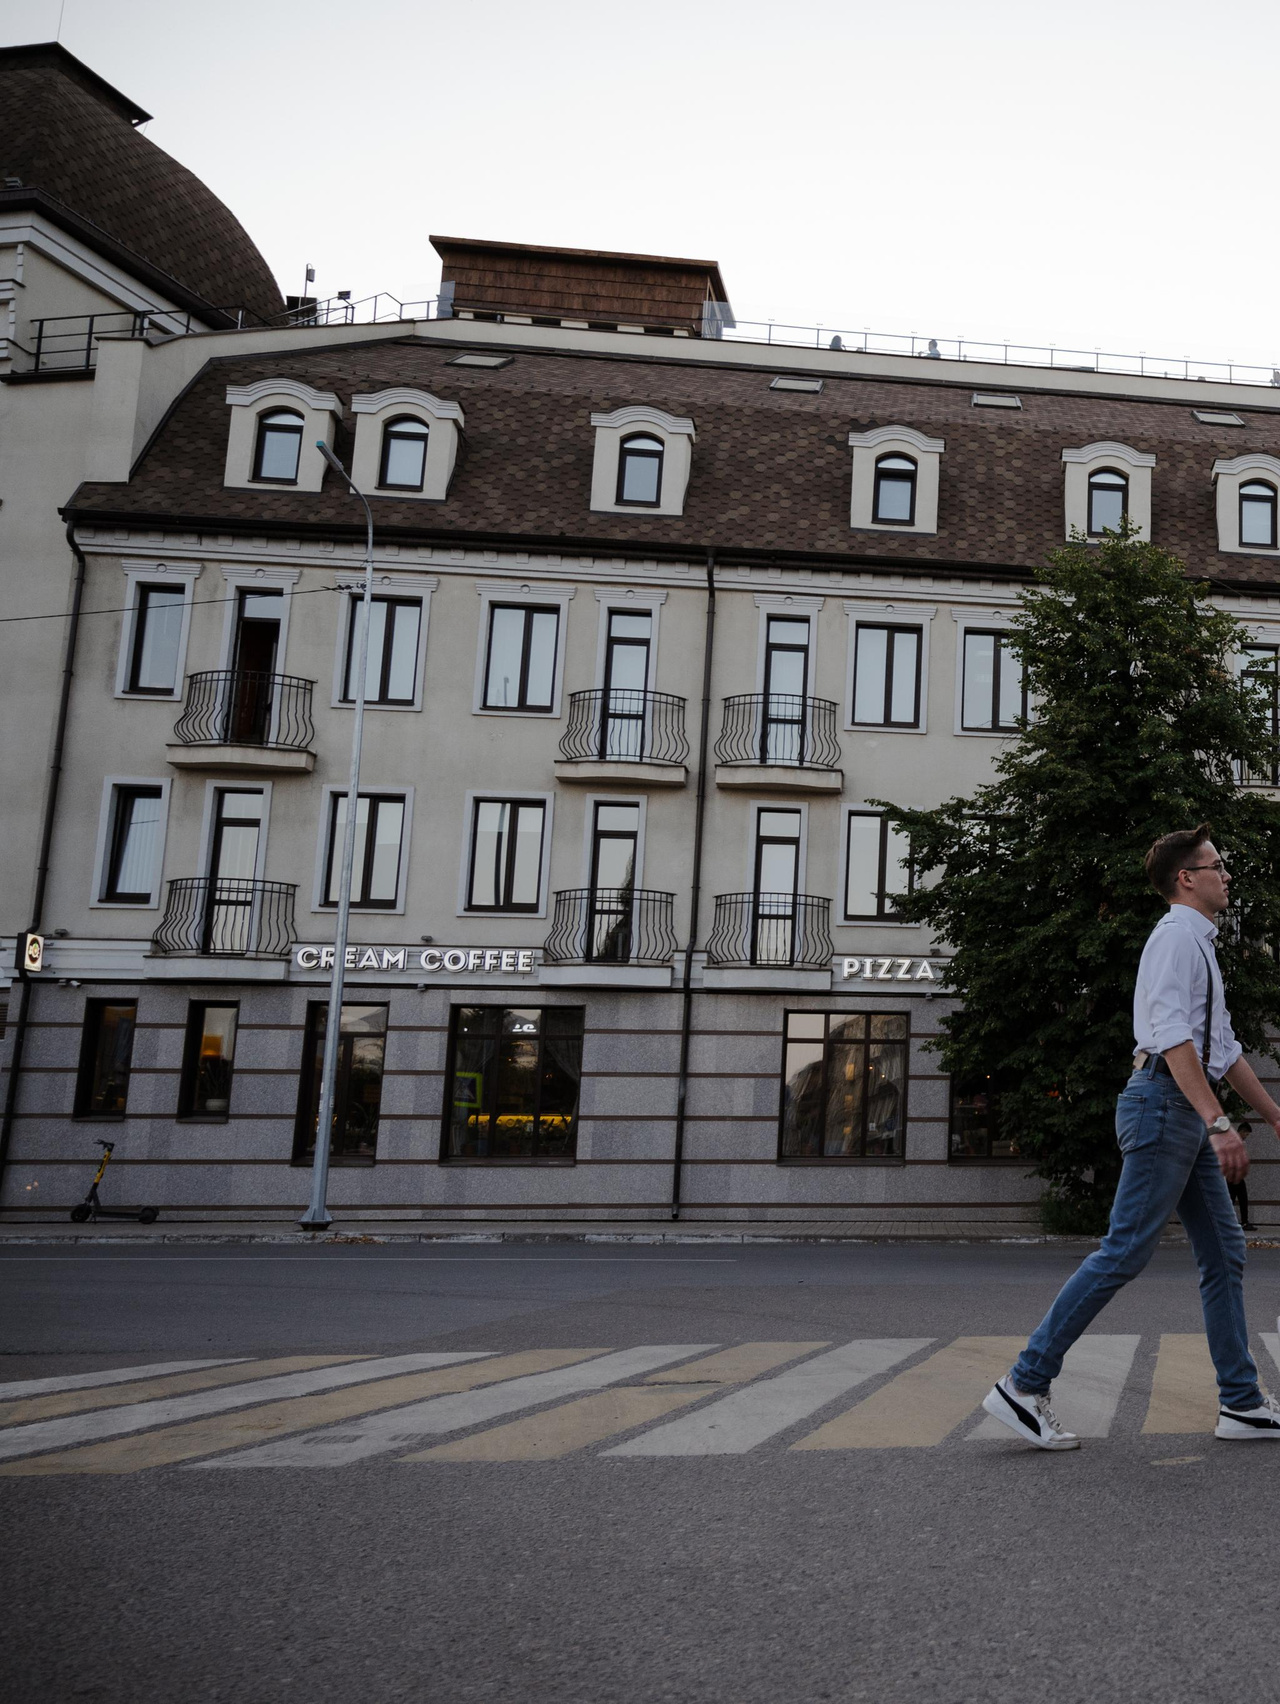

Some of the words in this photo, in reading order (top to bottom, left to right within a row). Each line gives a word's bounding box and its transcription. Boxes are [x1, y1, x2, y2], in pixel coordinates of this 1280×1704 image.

[297, 947, 408, 970] CREAM
[420, 949, 535, 973] COFFEE
[842, 958, 936, 981] PIZZA
